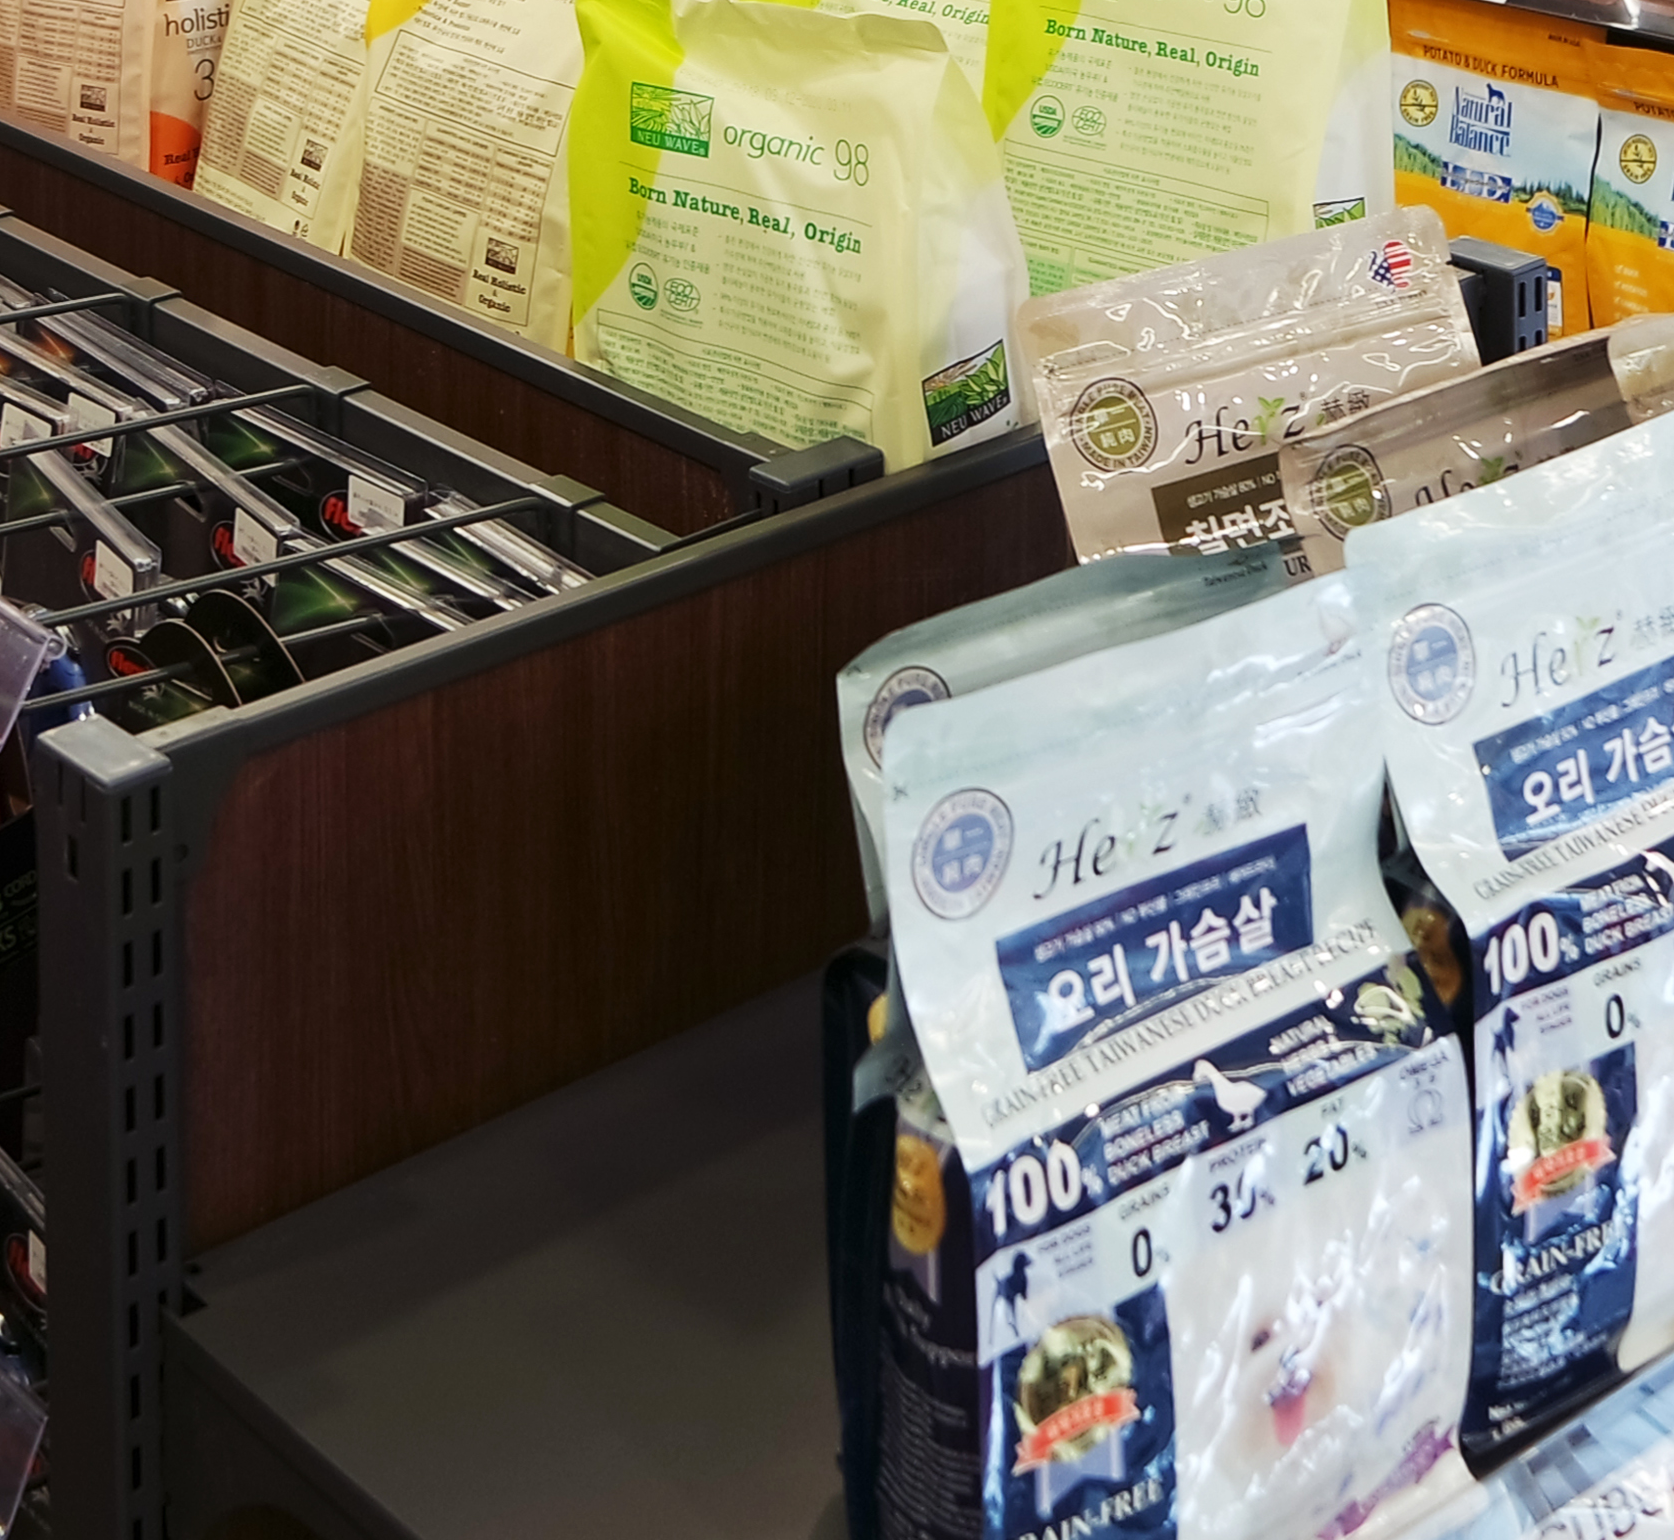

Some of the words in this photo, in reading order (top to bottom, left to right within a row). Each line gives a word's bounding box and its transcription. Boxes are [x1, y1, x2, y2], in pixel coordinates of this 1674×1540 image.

[941, 1, 991, 26] Origin
[1044, 19, 1087, 42] Born
[1091, 28, 1152, 59] Nature,
[1155, 41, 1200, 68] Real,
[1205, 51, 1260, 78] Origin
[1423, 45, 1462, 69] POTATO
[1463, 55, 1471, 69] &
[1471, 57, 1498, 77] DUCK
[1501, 65, 1559, 89] FORMULA
[193, 58, 216, 101] 3
[1039, 105, 1057, 116] USDA
[1453, 85, 1513, 129] Natural
[637, 130, 661, 148] NEU
[664, 136, 701, 155] WAVE
[723, 123, 825, 168] organic
[833, 138, 870, 187] 98
[1448, 117, 1511, 158] Balance
[628, 177, 667, 205] Born
[672, 189, 744, 225] Nature,
[747, 207, 796, 239] Real,
[804, 220, 862, 255] Origin
[472, 270, 489, 283] Real
[491, 277, 527, 295] Holistic
[636, 272, 653, 286] USDA
[479, 294, 511, 313] Organic
[941, 415, 968, 438] NEU
[970, 394, 1003, 422] WAVE
[1522, 747, 1594, 827] 요리
[1042, 940, 1137, 1027] 요리
[1145, 886, 1278, 984] 가슴살
[1483, 910, 1580, 996] 100%
[984, 1140, 1105, 1238] 100%
